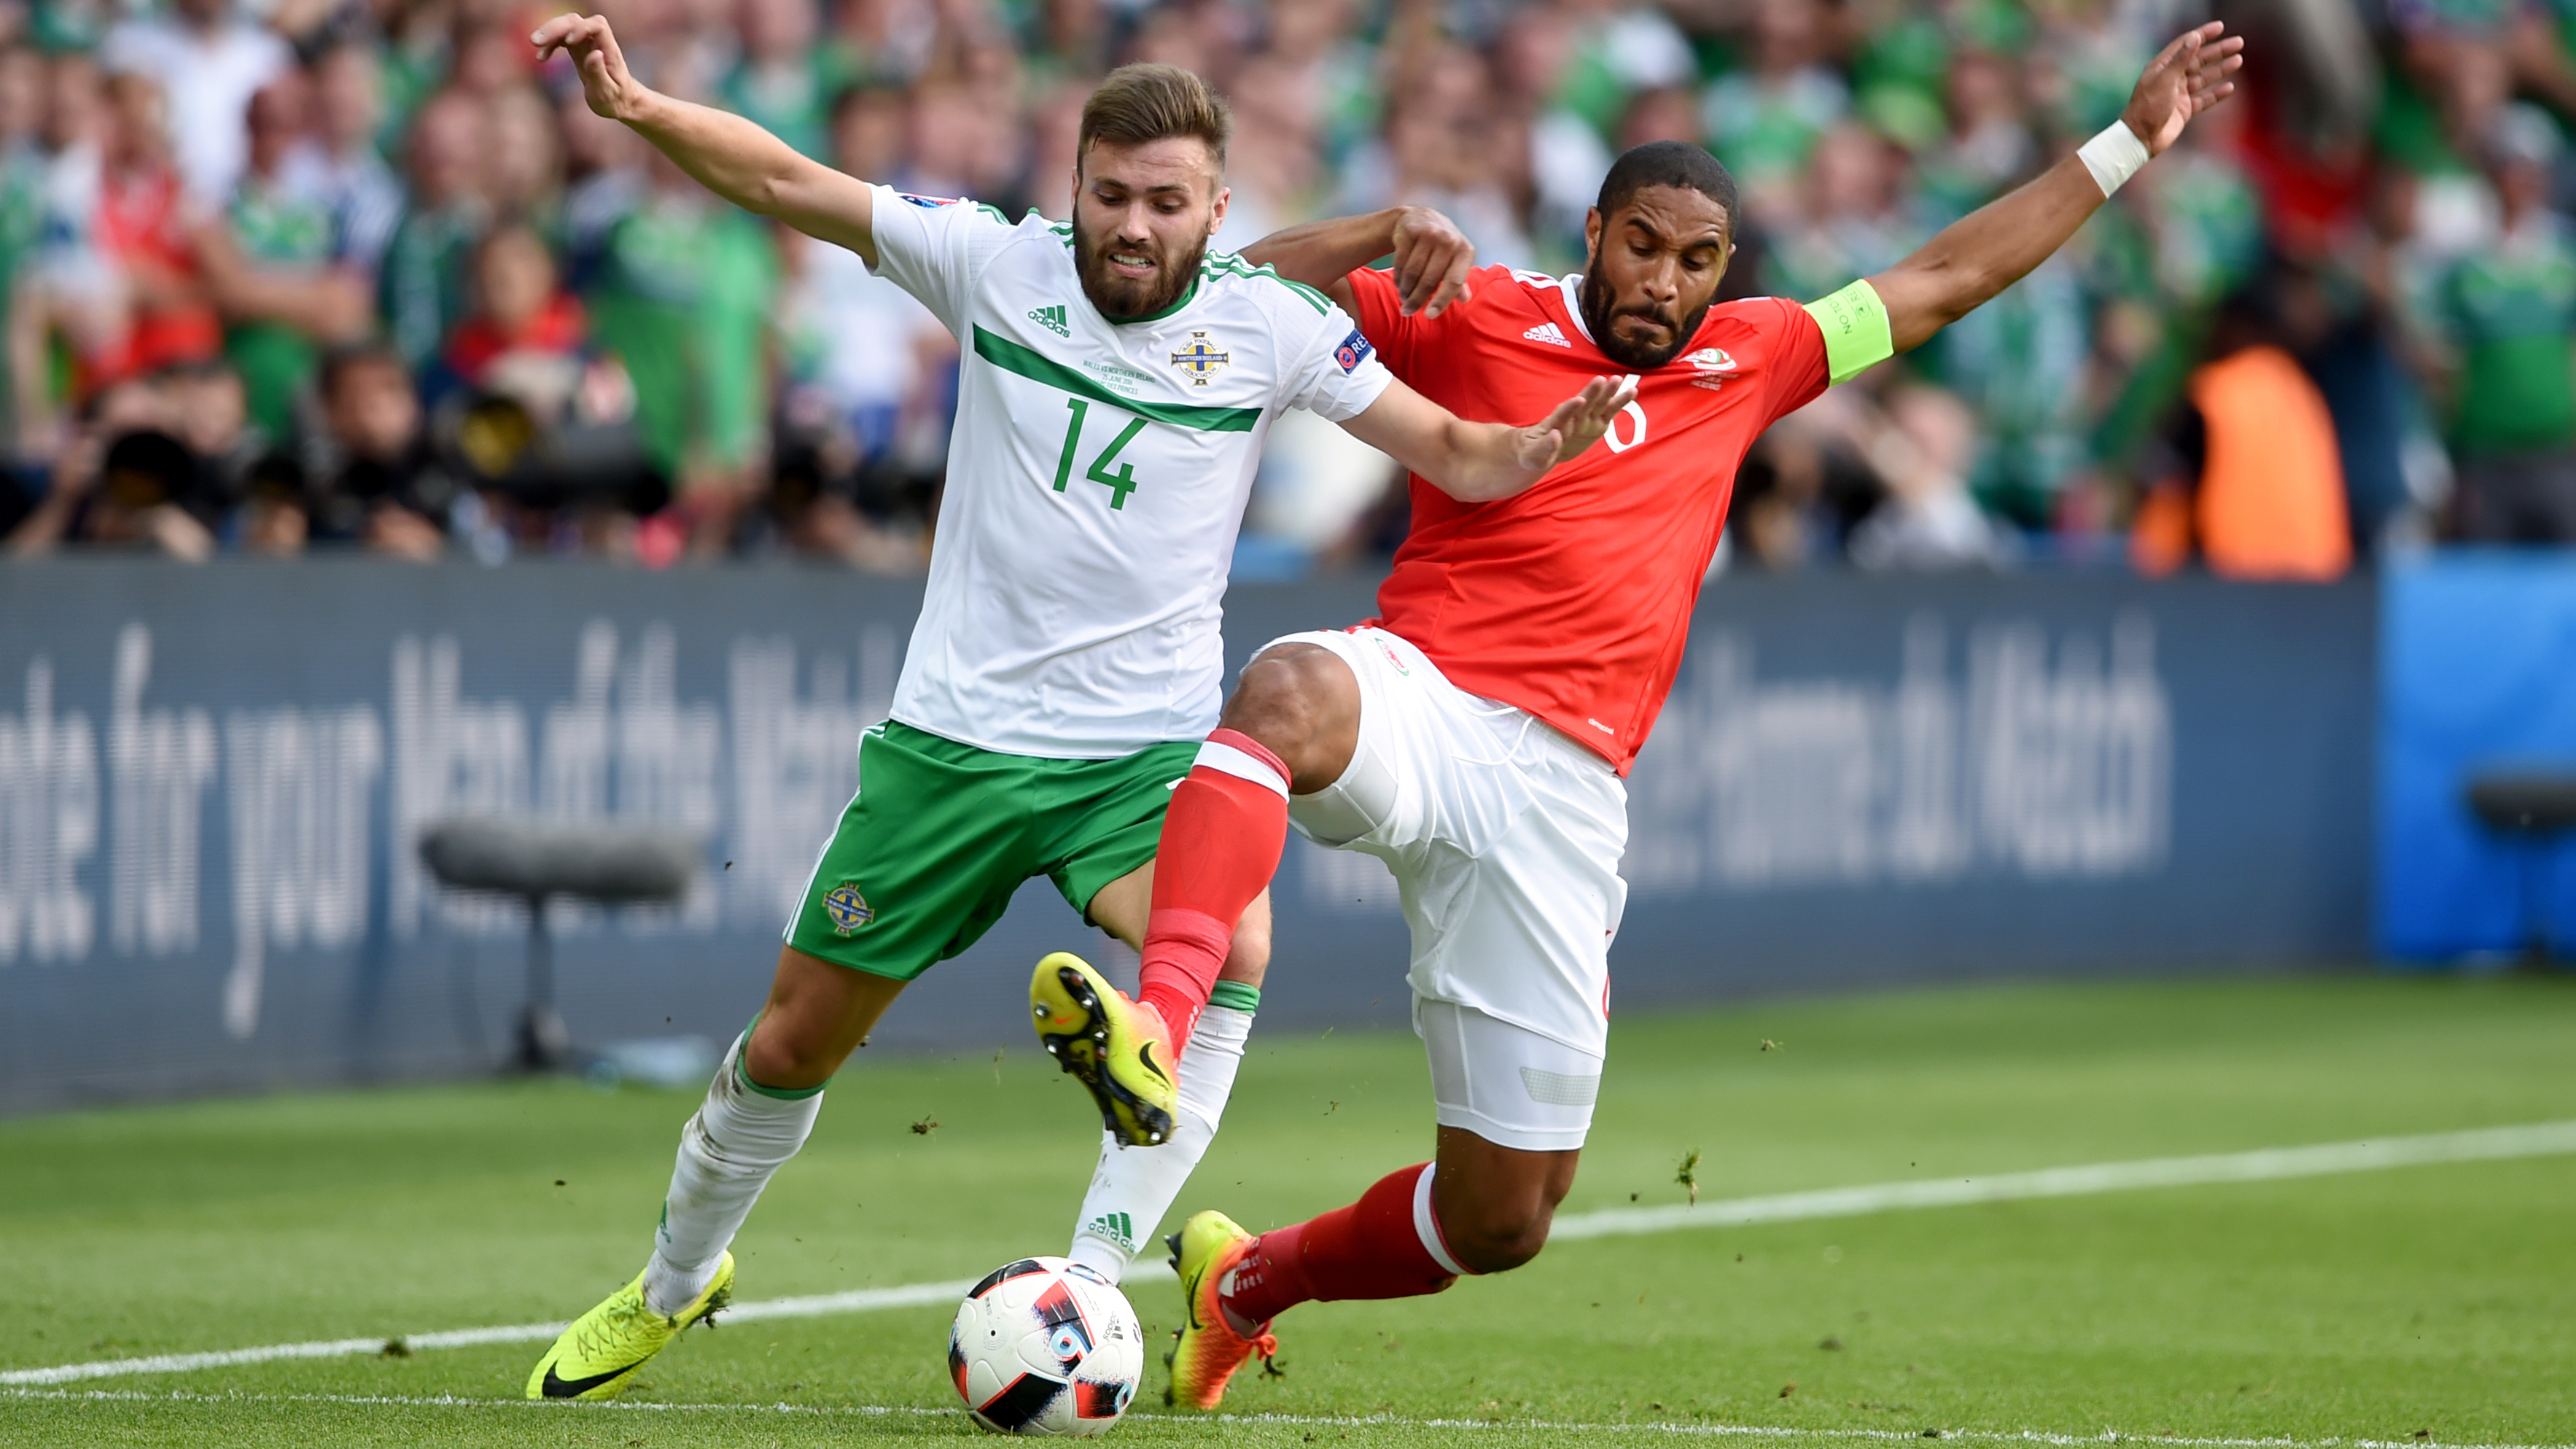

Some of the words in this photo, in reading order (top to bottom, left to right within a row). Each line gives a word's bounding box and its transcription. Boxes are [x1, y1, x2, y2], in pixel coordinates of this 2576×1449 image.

[1027, 311, 1070, 338] adidas
[1523, 331, 1572, 349] adidas
[1083, 360, 1100, 370] WALES
[1053, 397, 1149, 511] 14
[1088, 1222, 1136, 1253] adidas
